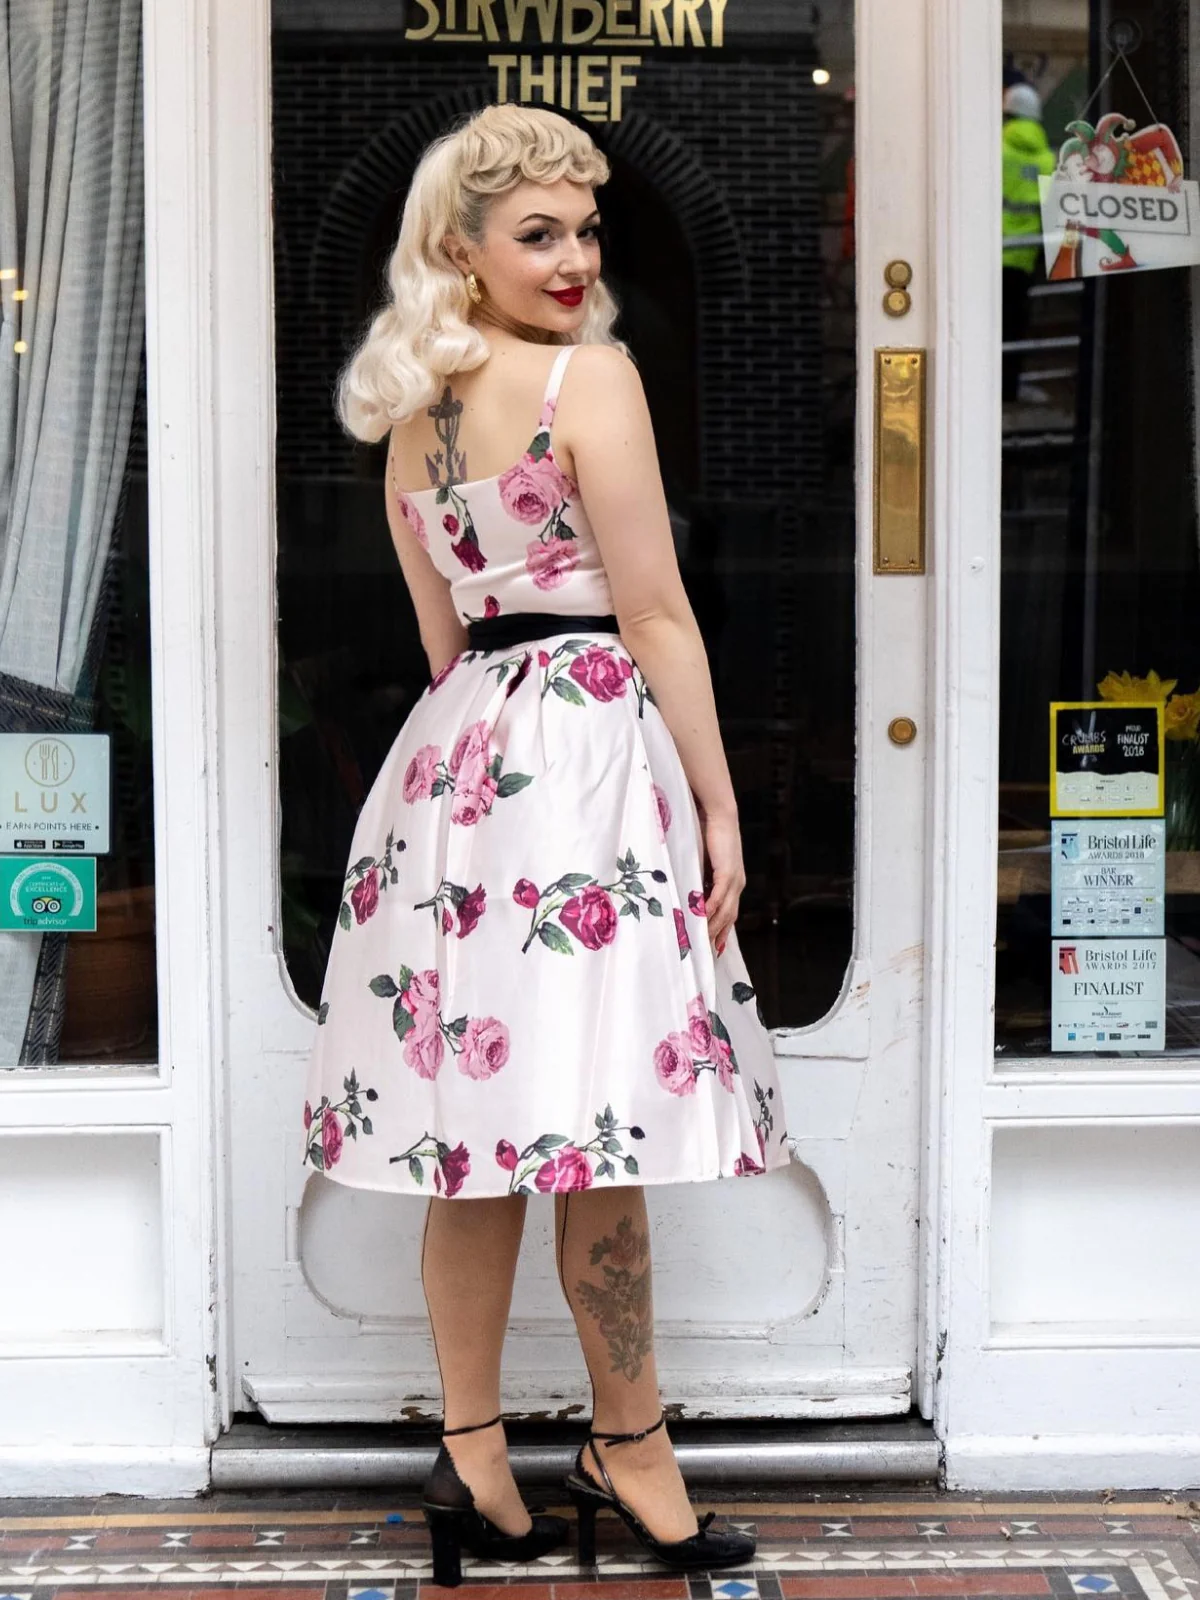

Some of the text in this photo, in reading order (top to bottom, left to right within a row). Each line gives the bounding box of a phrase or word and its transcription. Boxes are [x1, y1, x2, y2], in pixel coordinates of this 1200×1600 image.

[488, 54, 642, 122] THIEF
[1059, 192, 1178, 222] CLOSED
[1072, 743, 1105, 755] AWARDS
[1122, 745, 1145, 757] 2018
[14, 791, 87, 813] LUX
[6, 822, 92, 831] EARN POINTS HERE
[1088, 834, 1156, 850] Bristol Life
[1088, 851, 1124, 860] AWARDS
[1083, 874, 1134, 887] WINNER
[1085, 949, 1157, 961] Bristol Life
[1085, 962, 1157, 970] AWARDS 2017
[1073, 982, 1144, 996] FINALIST
